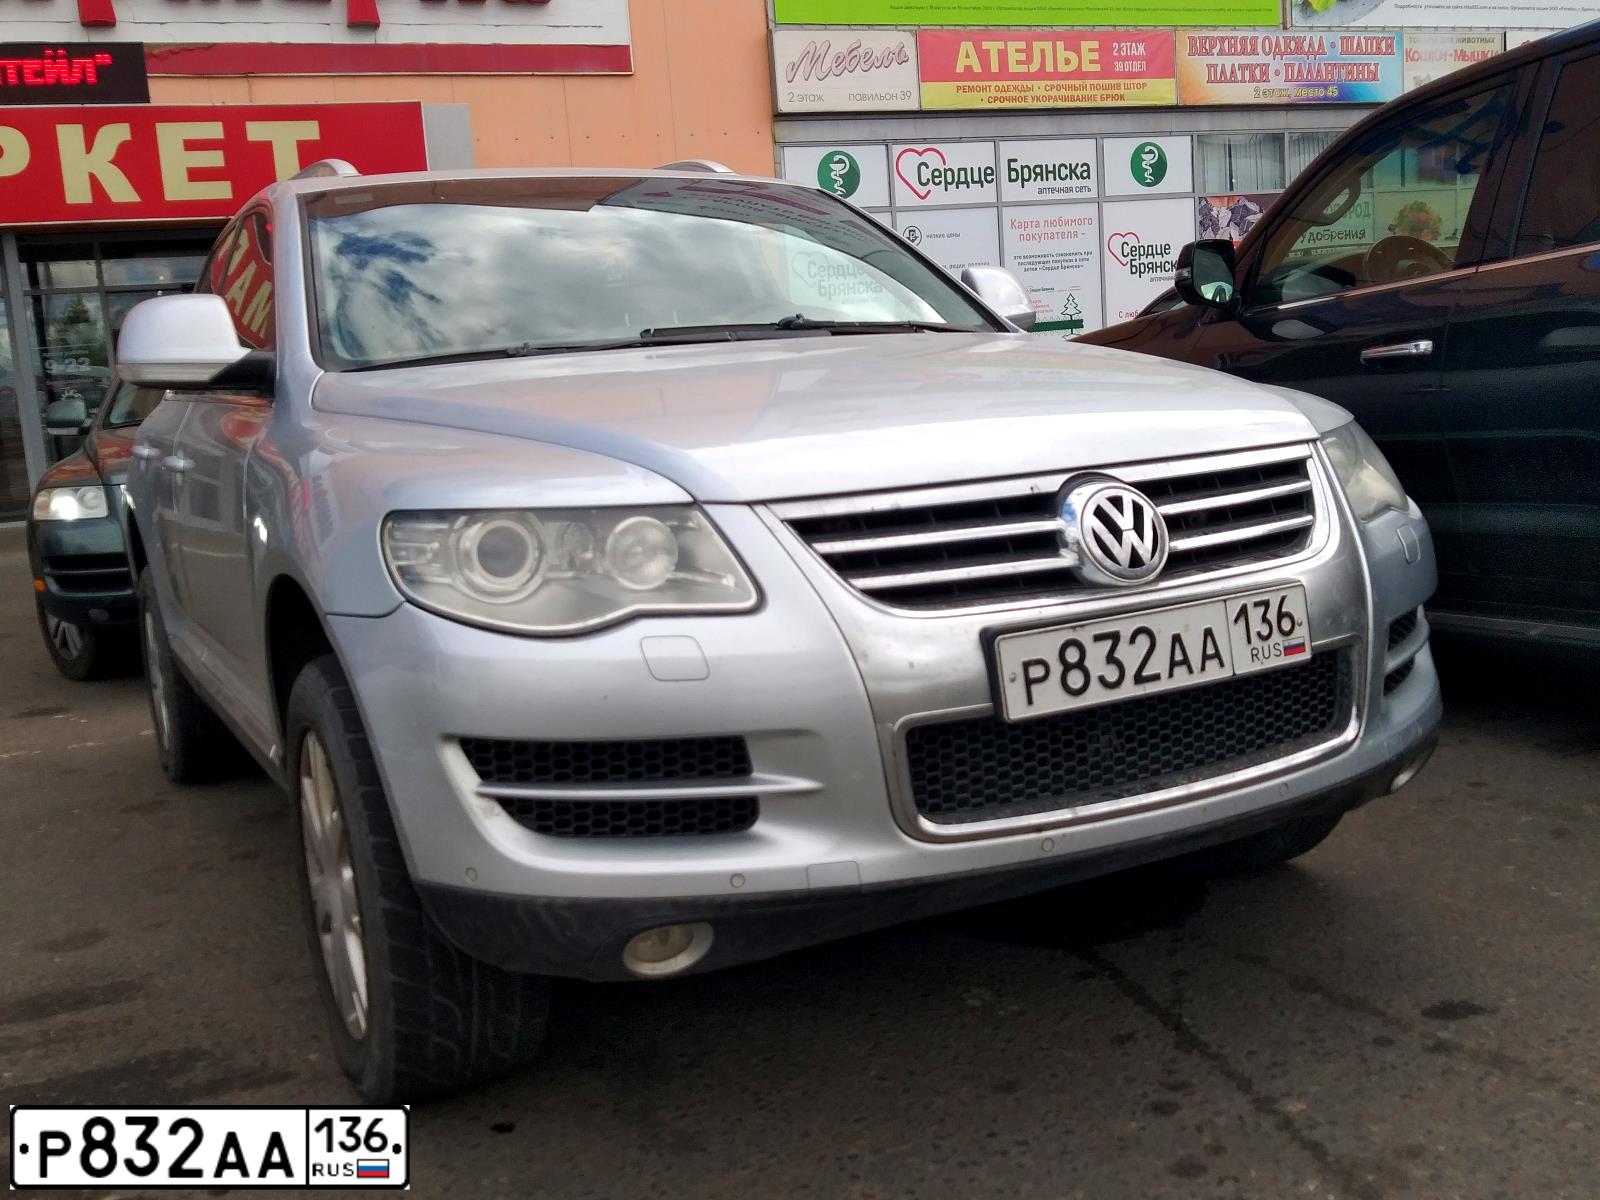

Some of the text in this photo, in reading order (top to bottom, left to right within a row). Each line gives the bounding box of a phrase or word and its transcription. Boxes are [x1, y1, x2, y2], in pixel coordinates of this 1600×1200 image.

[1112, 42, 1146, 57] 2 ЭТАЖ
[1187, 36, 1260, 57] ВЕРХНЯЯ
[1261, 36, 1328, 60] ОДЕЖДА
[1339, 36, 1396, 56] ШАПКИ
[786, 39, 910, 83] Мебель
[955, 40, 1102, 73] АТЕЛЬЕ
[1114, 61, 1147, 73] 39 ОТДЕЛ
[1206, 63, 1380, 84] ПЛАТКИ ПАЛАНТИНЫ
[956, 81, 1148, 93] РЕМОНТ ОДЕЖДЫ СРОЧНЫЙ ПОШИВ ШТОР
[1253, 85, 1339, 99] 2 этаж, место 45
[788, 92, 825, 103] 2 этаж
[848, 90, 912, 102] павильон 39
[987, 93, 1126, 104] СРОЧНОЕ УКОРАЧИВАНИЕ БРЮК
[917, 158, 1091, 192] Сердце Брянска
[1037, 185, 1092, 195] аптечная сеть
[1010, 216, 1093, 231] Карта любимого
[1019, 230, 1079, 243] покупателя
[1121, 241, 1171, 260] Сердце
[1130, 258, 1178, 279] Брянск
[1233, 594, 1297, 645] 136
[1250, 641, 1282, 664] RUS
